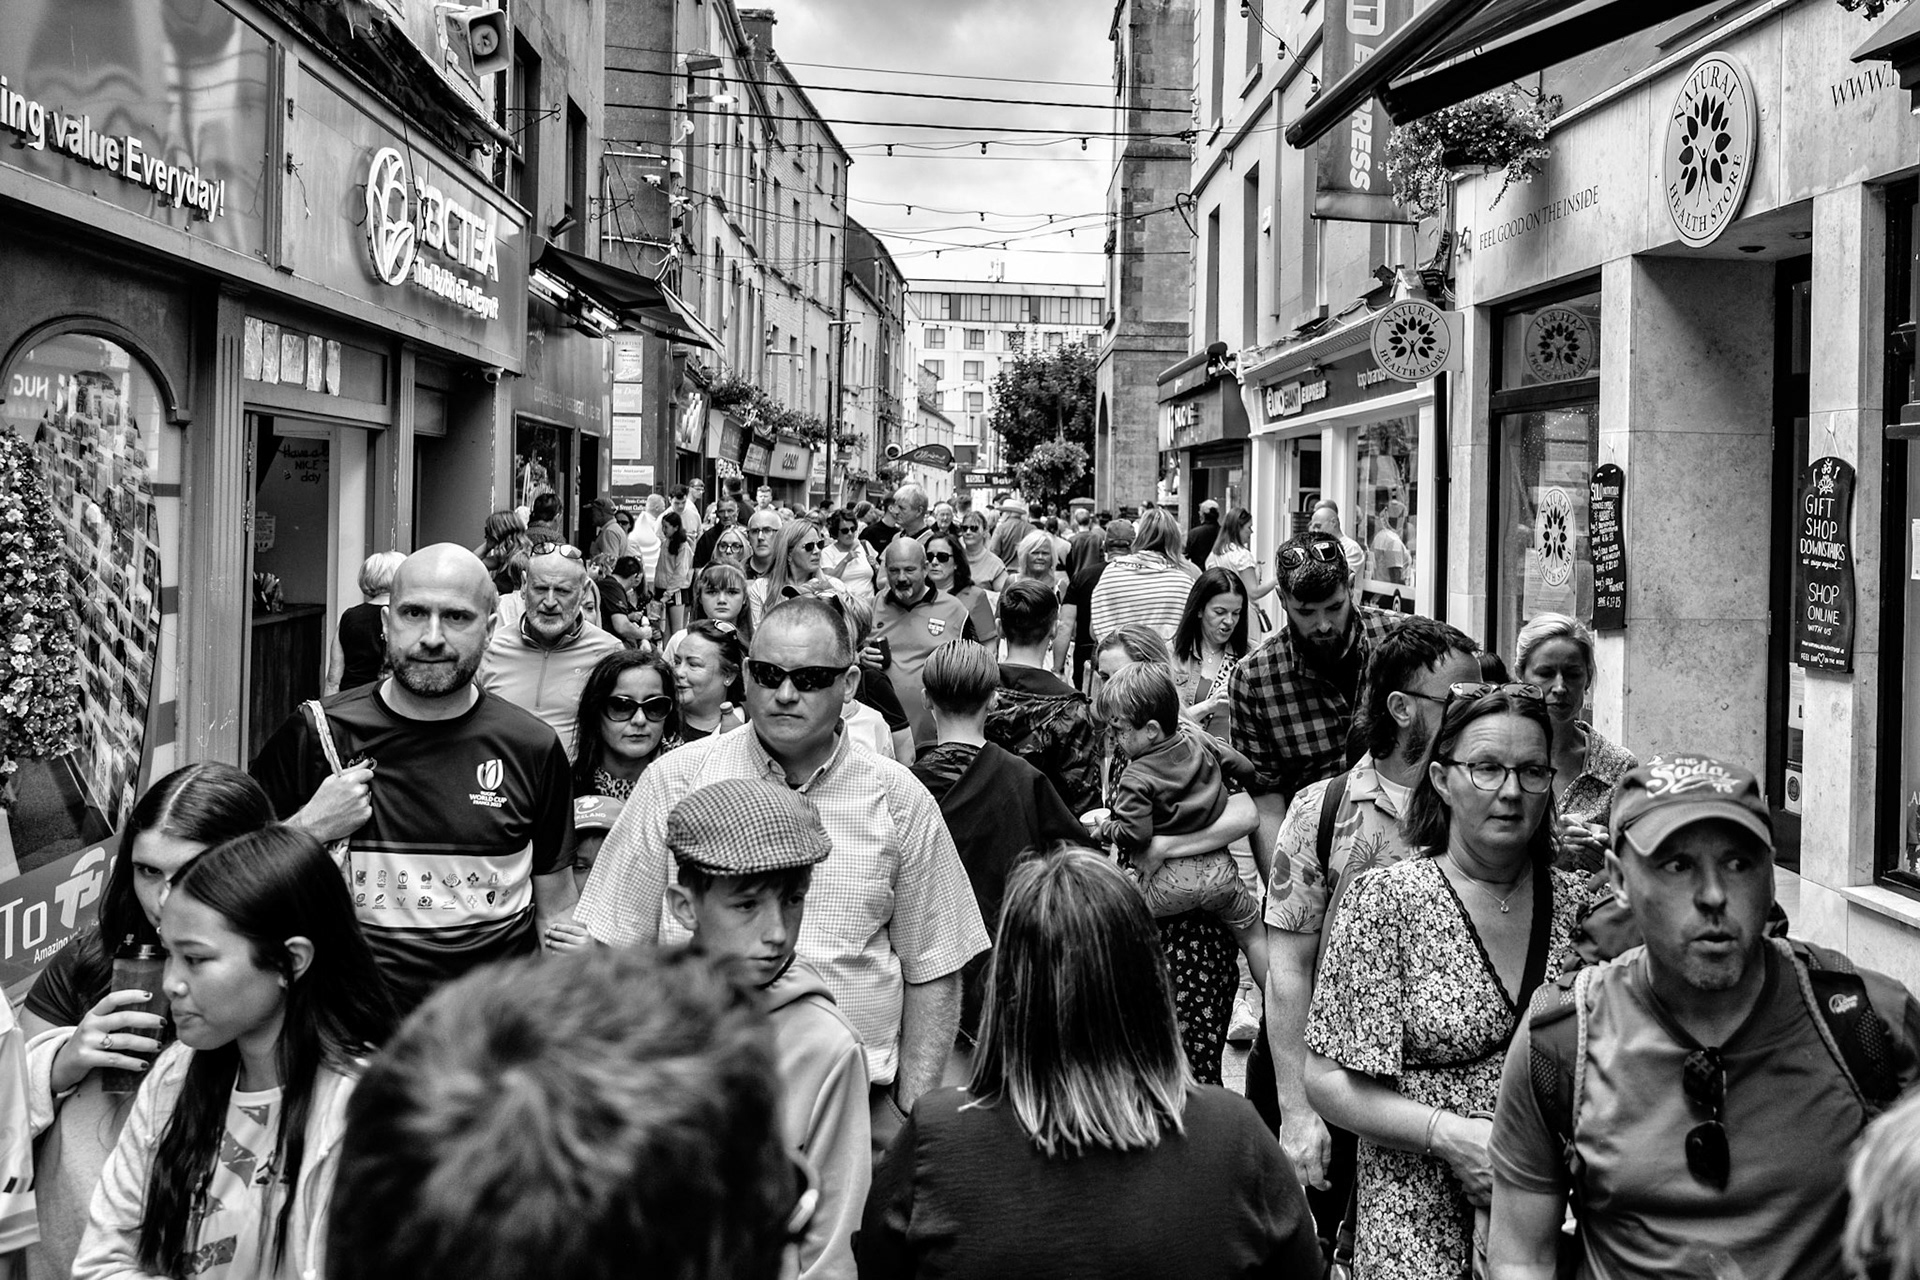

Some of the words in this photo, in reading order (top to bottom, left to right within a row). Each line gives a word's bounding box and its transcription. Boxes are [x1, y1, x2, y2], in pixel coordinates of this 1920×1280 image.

[1674, 66, 1737, 128] NATURAL
[48, 110, 120, 171] value
[120, 134, 225, 222] Everyday!
[1669, 182, 1707, 233] HEALTH
[1711, 154, 1743, 226] STORE
[1480, 229, 1496, 250] FEEL
[1497, 217, 1525, 243] GOOD
[1525, 210, 1541, 232] ON
[1542, 201, 1561, 225] THE
[1563, 185, 1599, 217] INSIDE
[1383, 305, 1440, 328] NATURAL
[1380, 349, 1417, 377] HEALTH
[1419, 347, 1446, 375] STORE
[1357, 372, 1367, 390] top
[295, 460, 319, 470] NICE
[301, 470, 321, 484] day
[1541, 493, 1570, 520] NATURAL
[1805, 494, 1835, 518] GIFT
[1805, 517, 1838, 541] SHOP
[1800, 538, 1845, 561] DOWNSTAIRS
[1538, 546, 1557, 582] HEALTH
[1808, 582, 1840, 605] SHOP
[1807, 605, 1840, 625] ONLINE
[1807, 624, 1823, 633] WITH
[1823, 628, 1832, 636] US
[1646, 760, 1724, 798] Soda
[469, 793, 491, 803] WORLD
[492, 796, 508, 804] CUP
